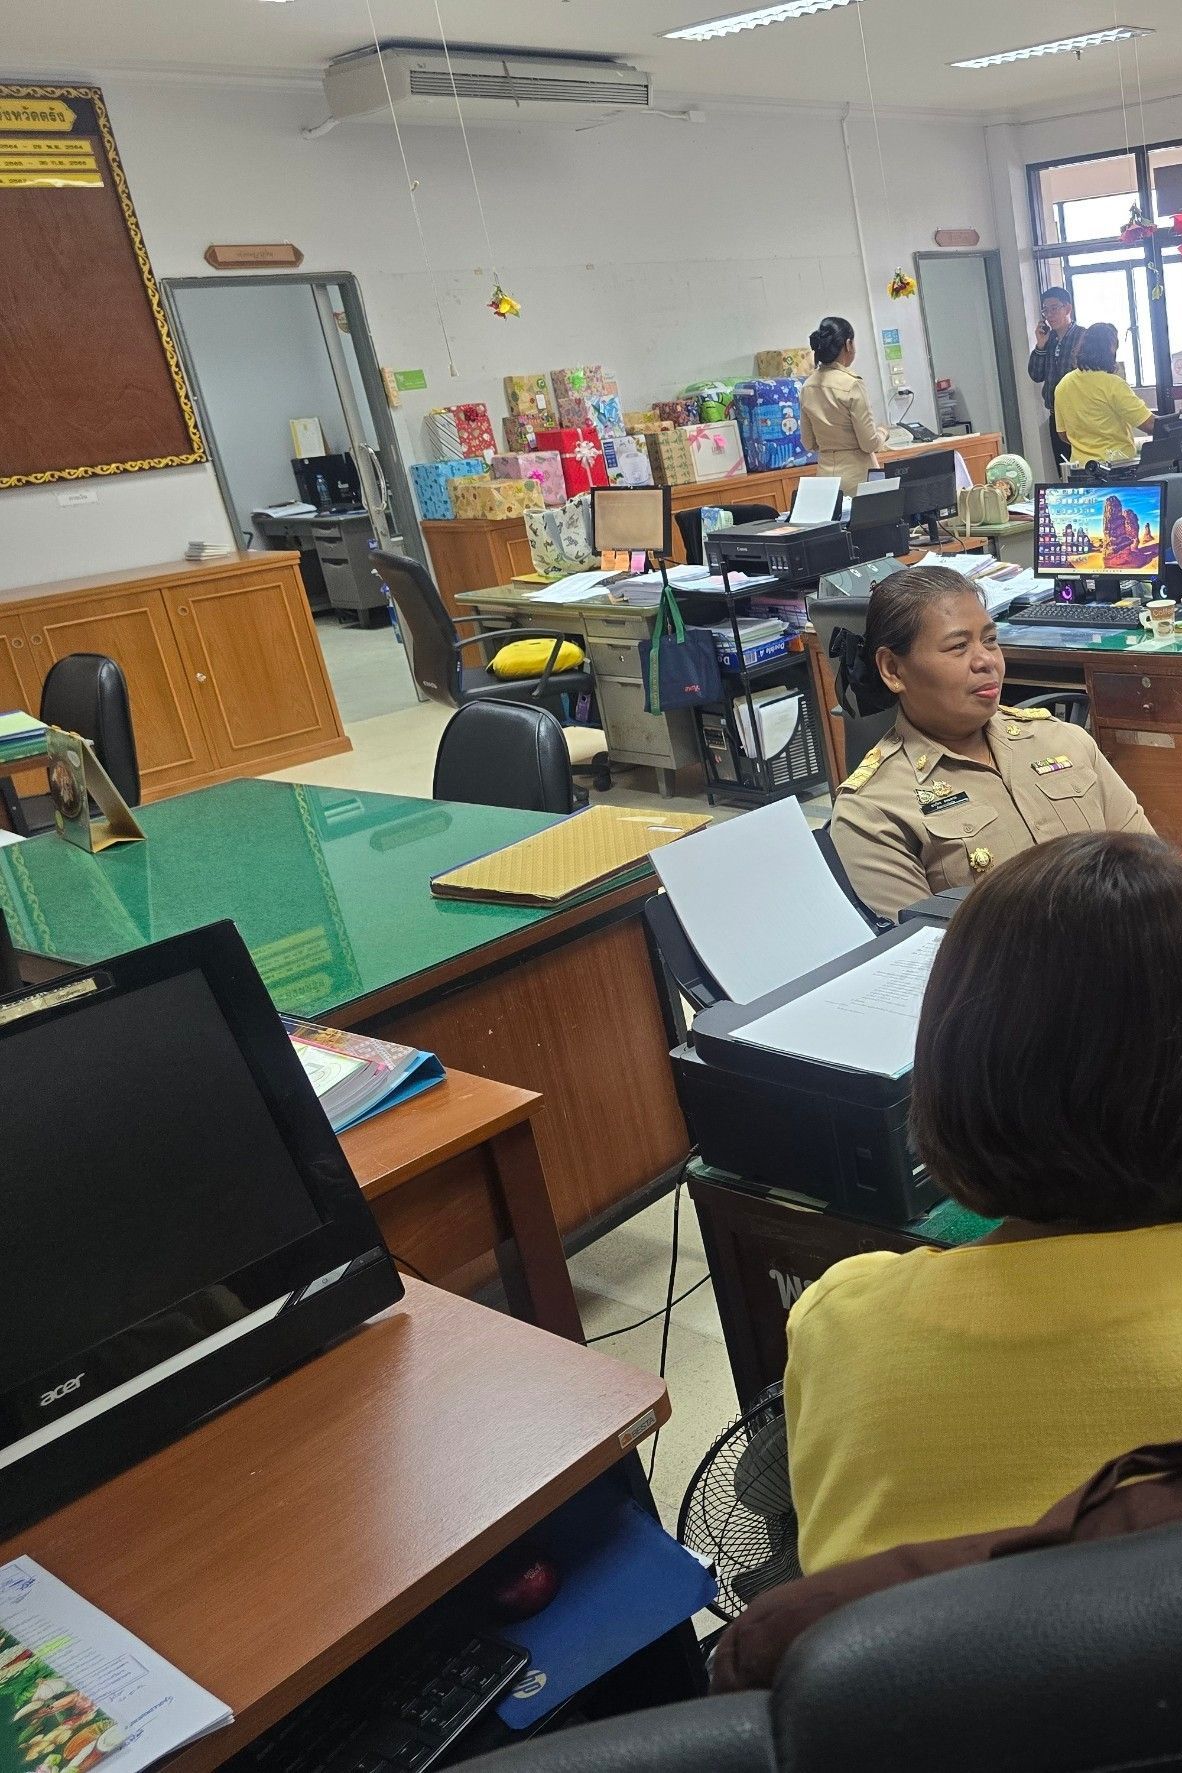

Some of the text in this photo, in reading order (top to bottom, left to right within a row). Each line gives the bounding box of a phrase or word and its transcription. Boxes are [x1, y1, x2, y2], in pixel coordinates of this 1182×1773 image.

[0, 106, 66, 122] งหวัดตรัง
[765, 641, 785, 655] Double
[40, 1372, 86, 1407] acer
[632, 1415, 656, 1437] BESTA
